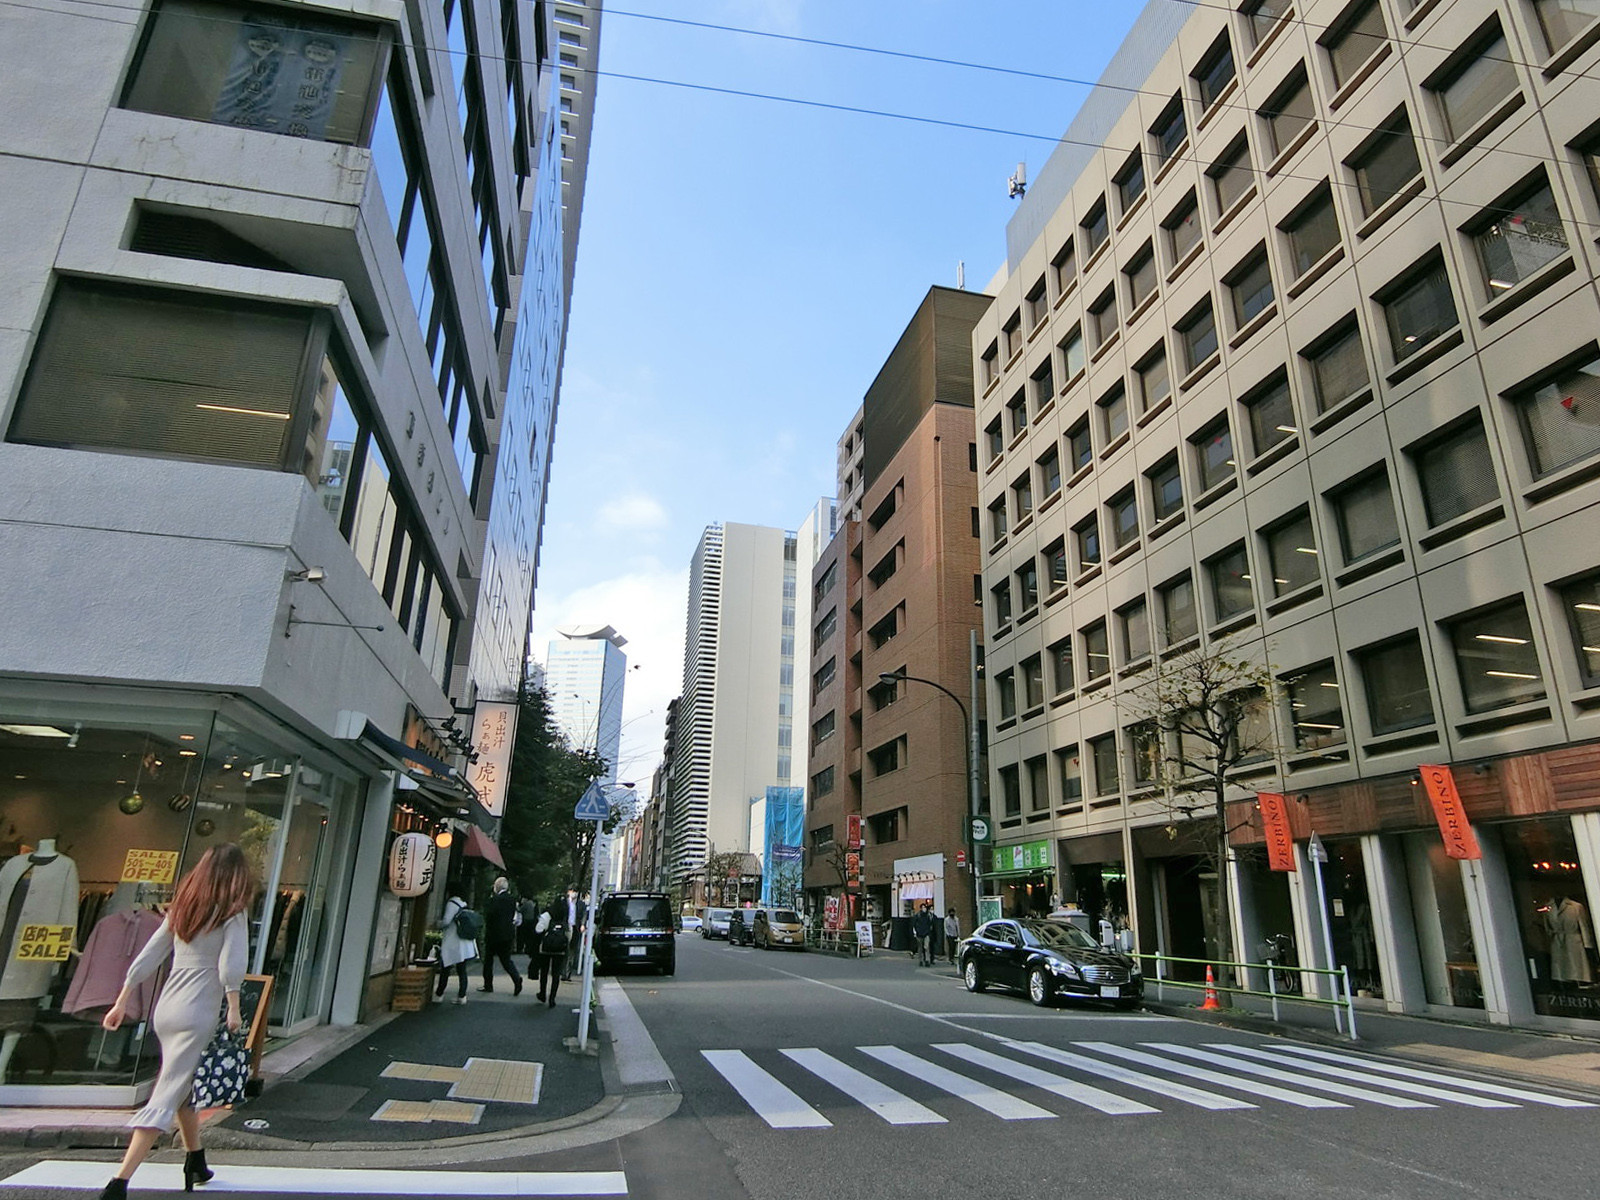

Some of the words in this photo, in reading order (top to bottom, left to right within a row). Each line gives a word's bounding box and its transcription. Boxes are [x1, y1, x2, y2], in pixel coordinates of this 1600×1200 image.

[477, 718, 491, 755] らぁ麺
[493, 711, 507, 749] 貝出汁
[1432, 771, 1467, 855] ZERBINO
[1267, 799, 1290, 866] ZERBINO
[128, 851, 176, 860] SALE!
[123, 867, 171, 882] OFF!
[22, 925, 73, 942] 店内一部
[18, 943, 70, 958] SALE
